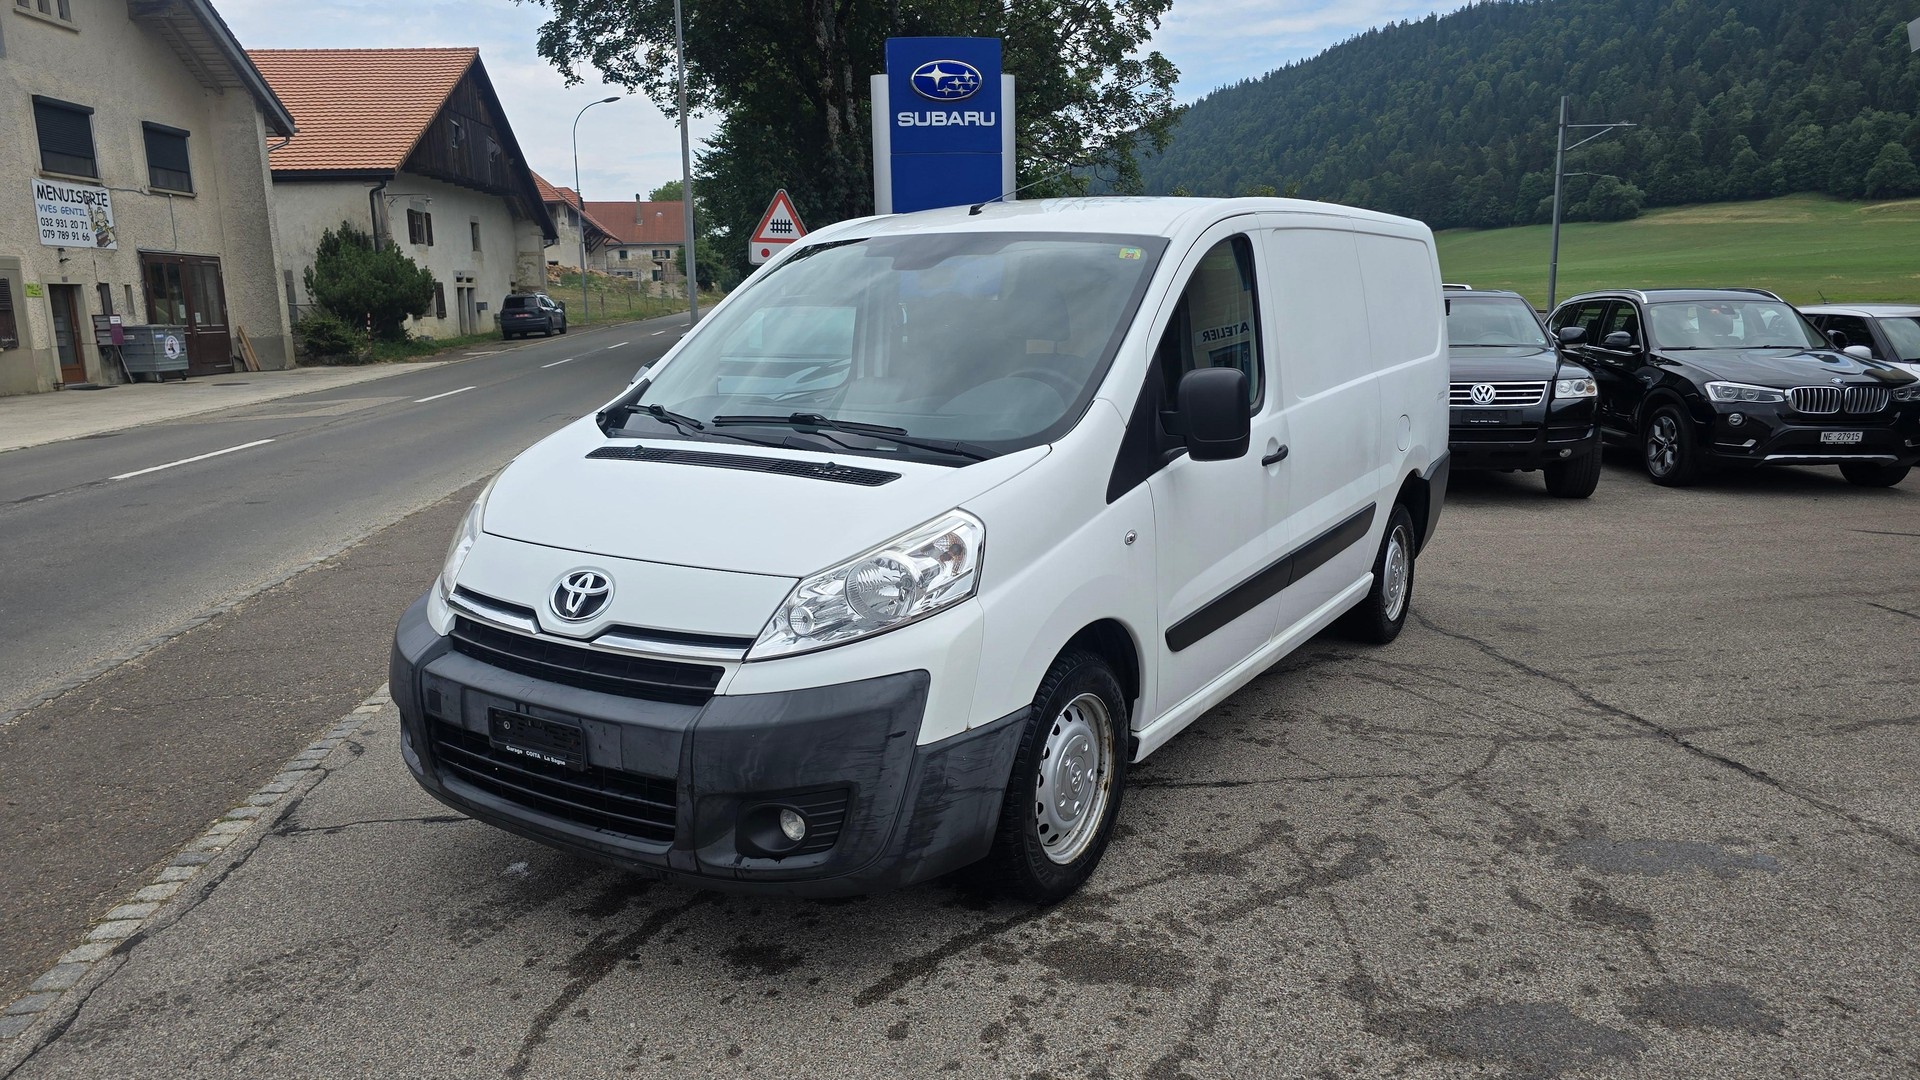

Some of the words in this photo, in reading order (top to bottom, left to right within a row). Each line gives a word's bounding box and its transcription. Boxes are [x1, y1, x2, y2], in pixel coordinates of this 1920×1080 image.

[897, 111, 996, 127] SUBARU
[36, 184, 109, 208] MENUISERIE
[38, 204, 58, 214] YVES
[60, 206, 87, 217] GENTIL
[40, 217, 54, 227] 032
[55, 218, 68, 229] 931
[70, 220, 79, 230] 20
[80, 221, 88, 230] 71
[42, 229, 56, 239] 079
[57, 230, 70, 240] 789
[71, 231, 80, 241] 91
[81, 232, 91, 242] 66
[505, 745, 523, 755] Garage
